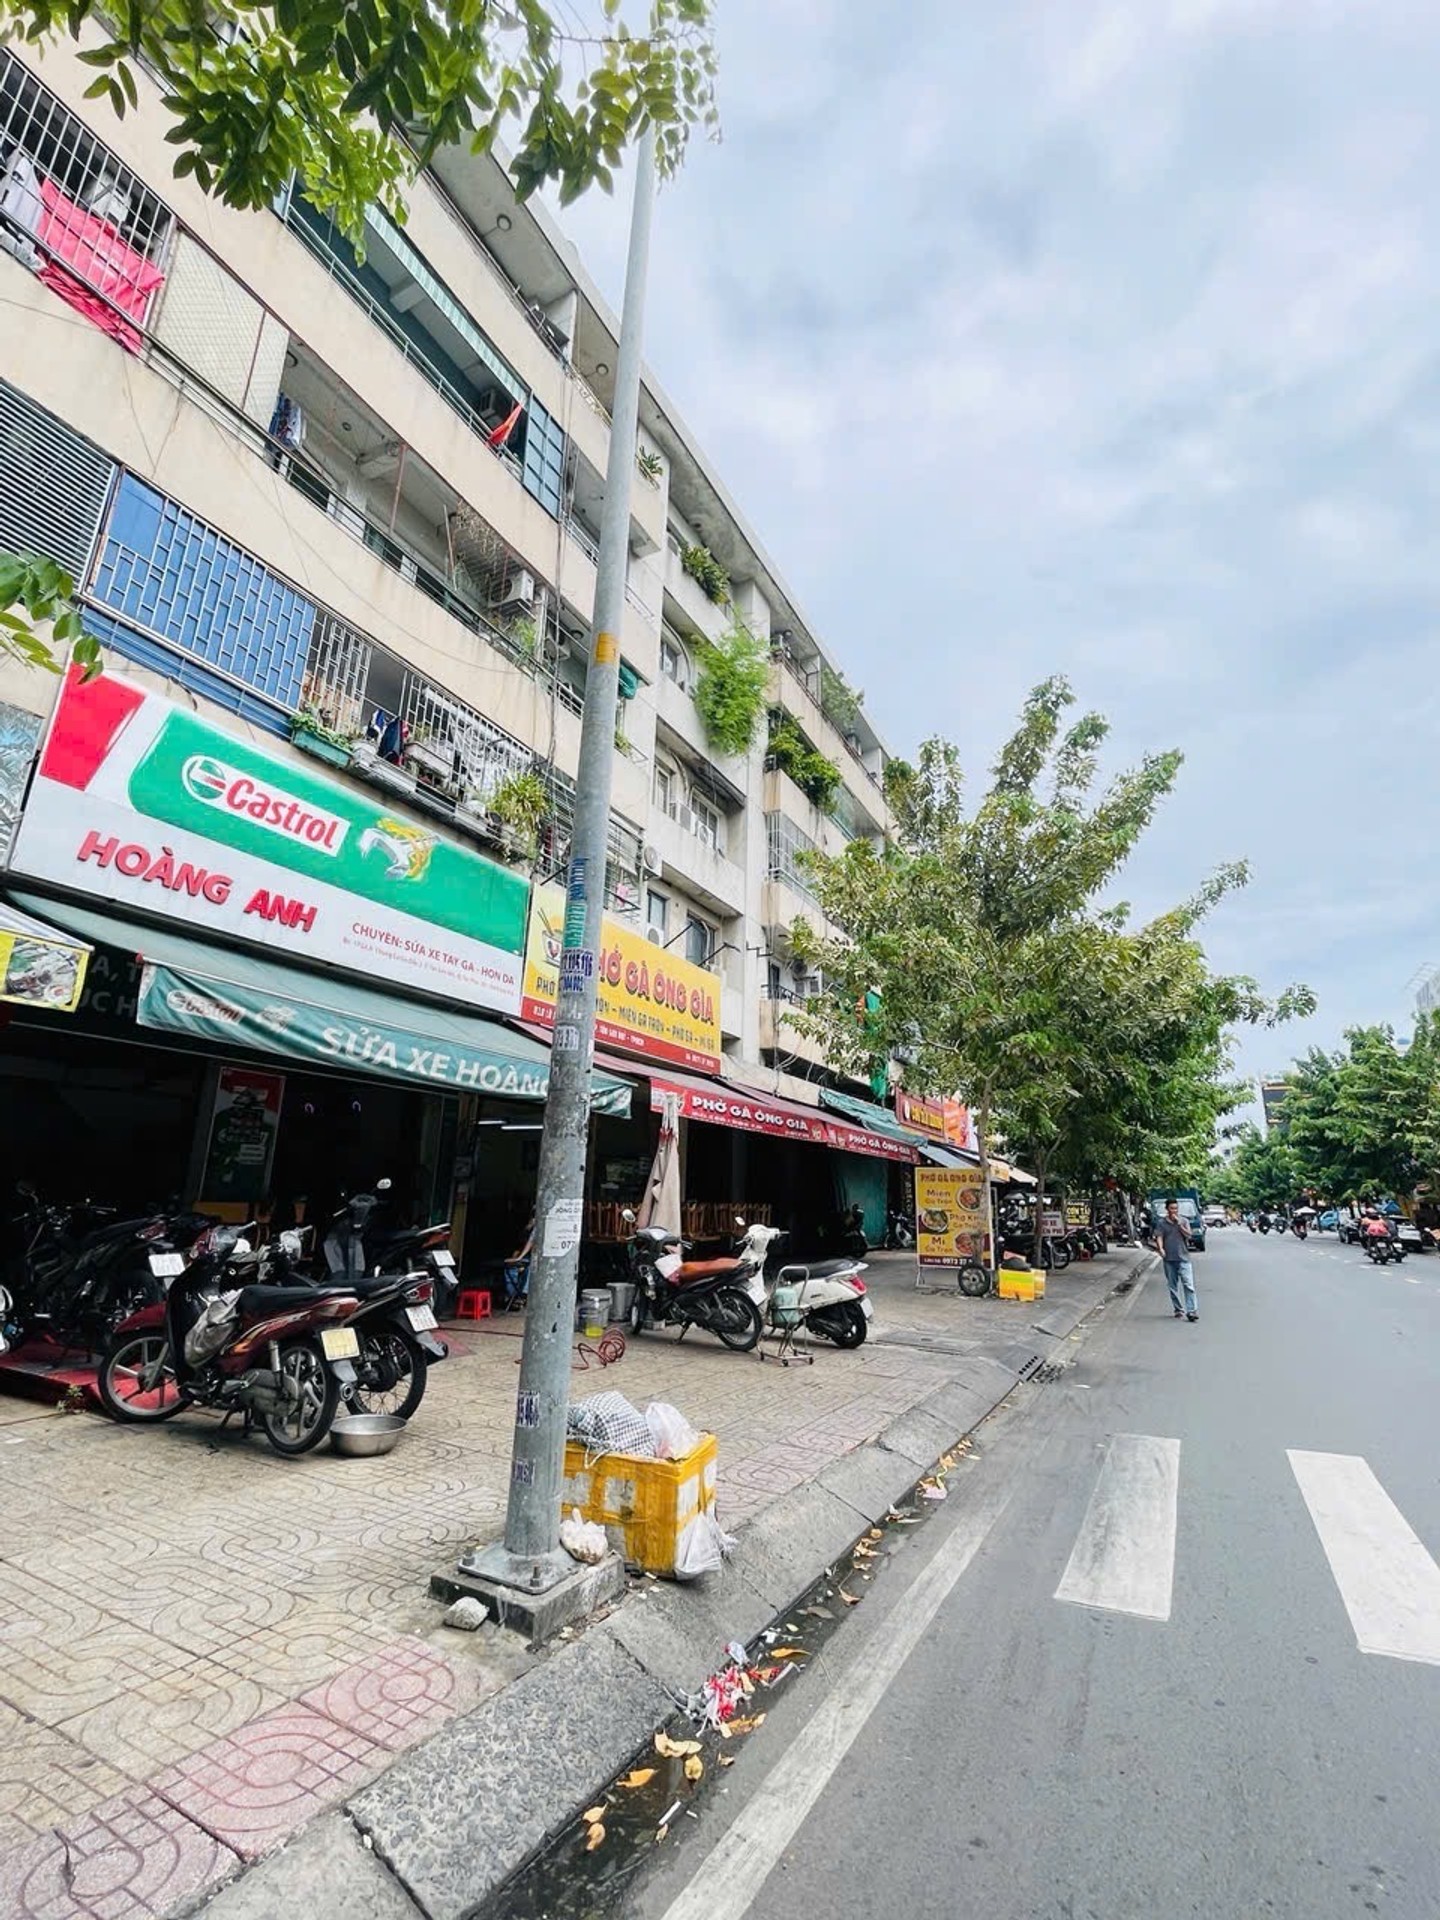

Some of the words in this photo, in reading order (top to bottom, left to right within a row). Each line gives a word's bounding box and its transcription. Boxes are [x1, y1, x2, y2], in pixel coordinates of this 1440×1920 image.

[225, 778, 340, 850] Castrol
[77, 829, 235, 906] HOÀNG
[243, 888, 319, 932] ANH
[428, 948, 441, 961] XE
[461, 960, 474, 972] GA
[625, 960, 651, 1001] GÀ
[314, 1024, 398, 1069] SỬA
[405, 1050, 452, 1080] XE
[691, 1093, 728, 1113] PHỞ
[730, 1104, 753, 1120] GÀ
[754, 1109, 784, 1126] ÔNG
